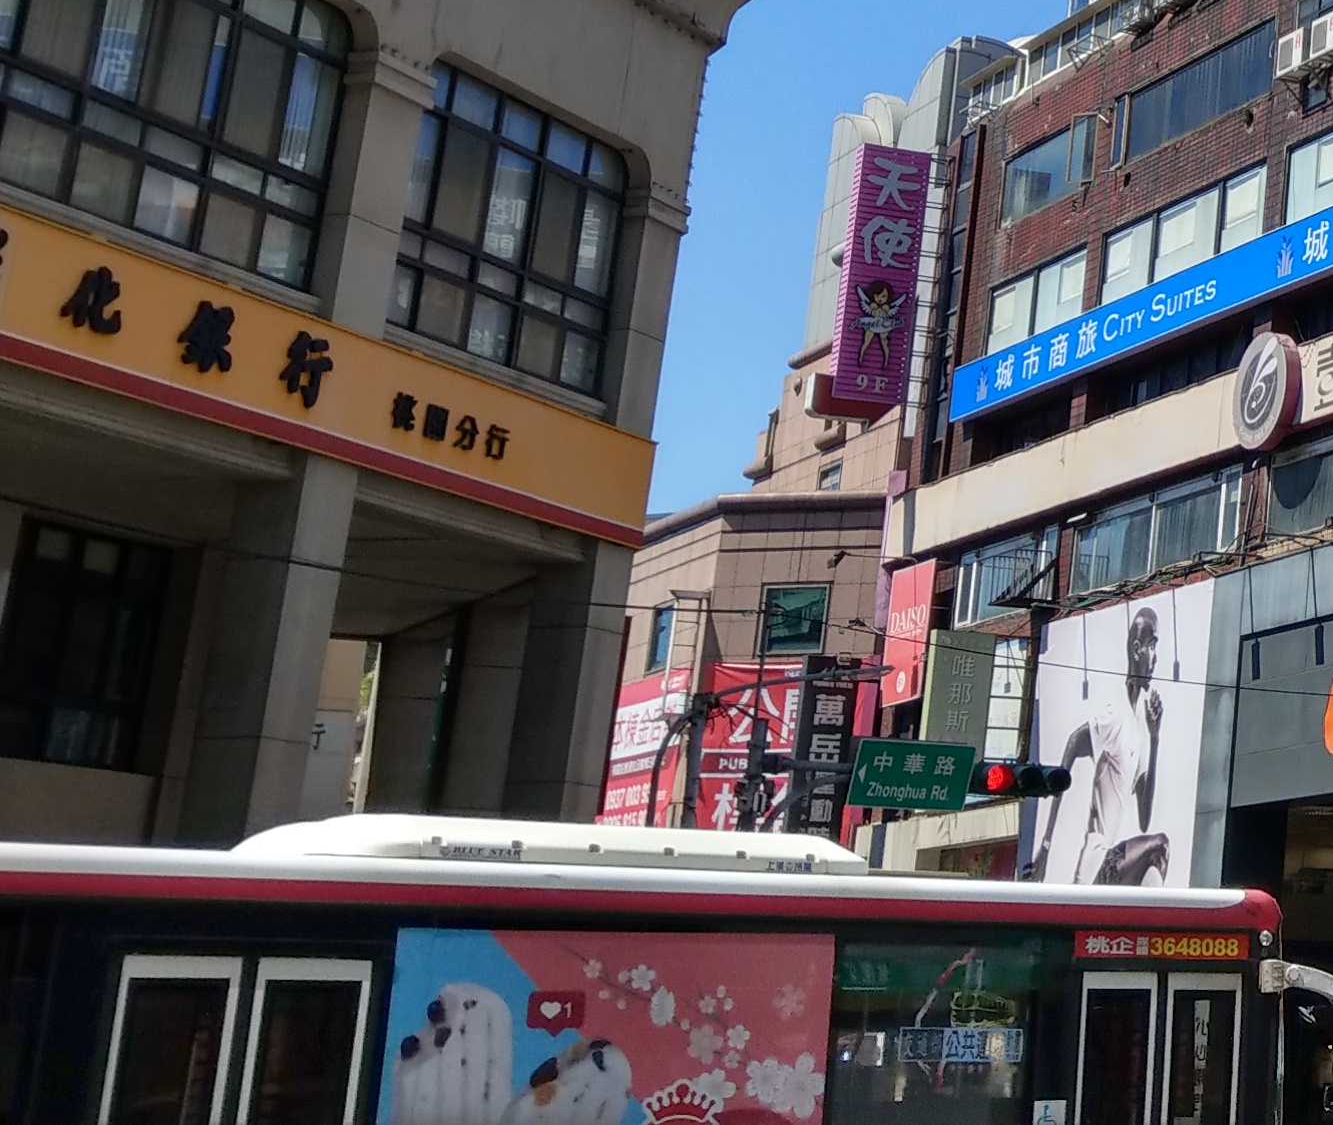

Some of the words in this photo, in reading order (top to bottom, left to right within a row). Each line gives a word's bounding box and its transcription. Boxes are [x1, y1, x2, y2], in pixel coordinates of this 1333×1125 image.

[861, 156, 921, 269] 天使
[994, 321, 1098, 391] 城市商旅
[390, 392, 510, 461] 桃園分行
[889, 603, 927, 635] DAISO
[945, 655, 976, 733] 唯那斯
[873, 752, 957, 776] 中華路
[866, 782, 927, 802] Zhonghua
[1086, 935, 1134, 955] 桃企
[1150, 937, 1239, 957] 3648088
